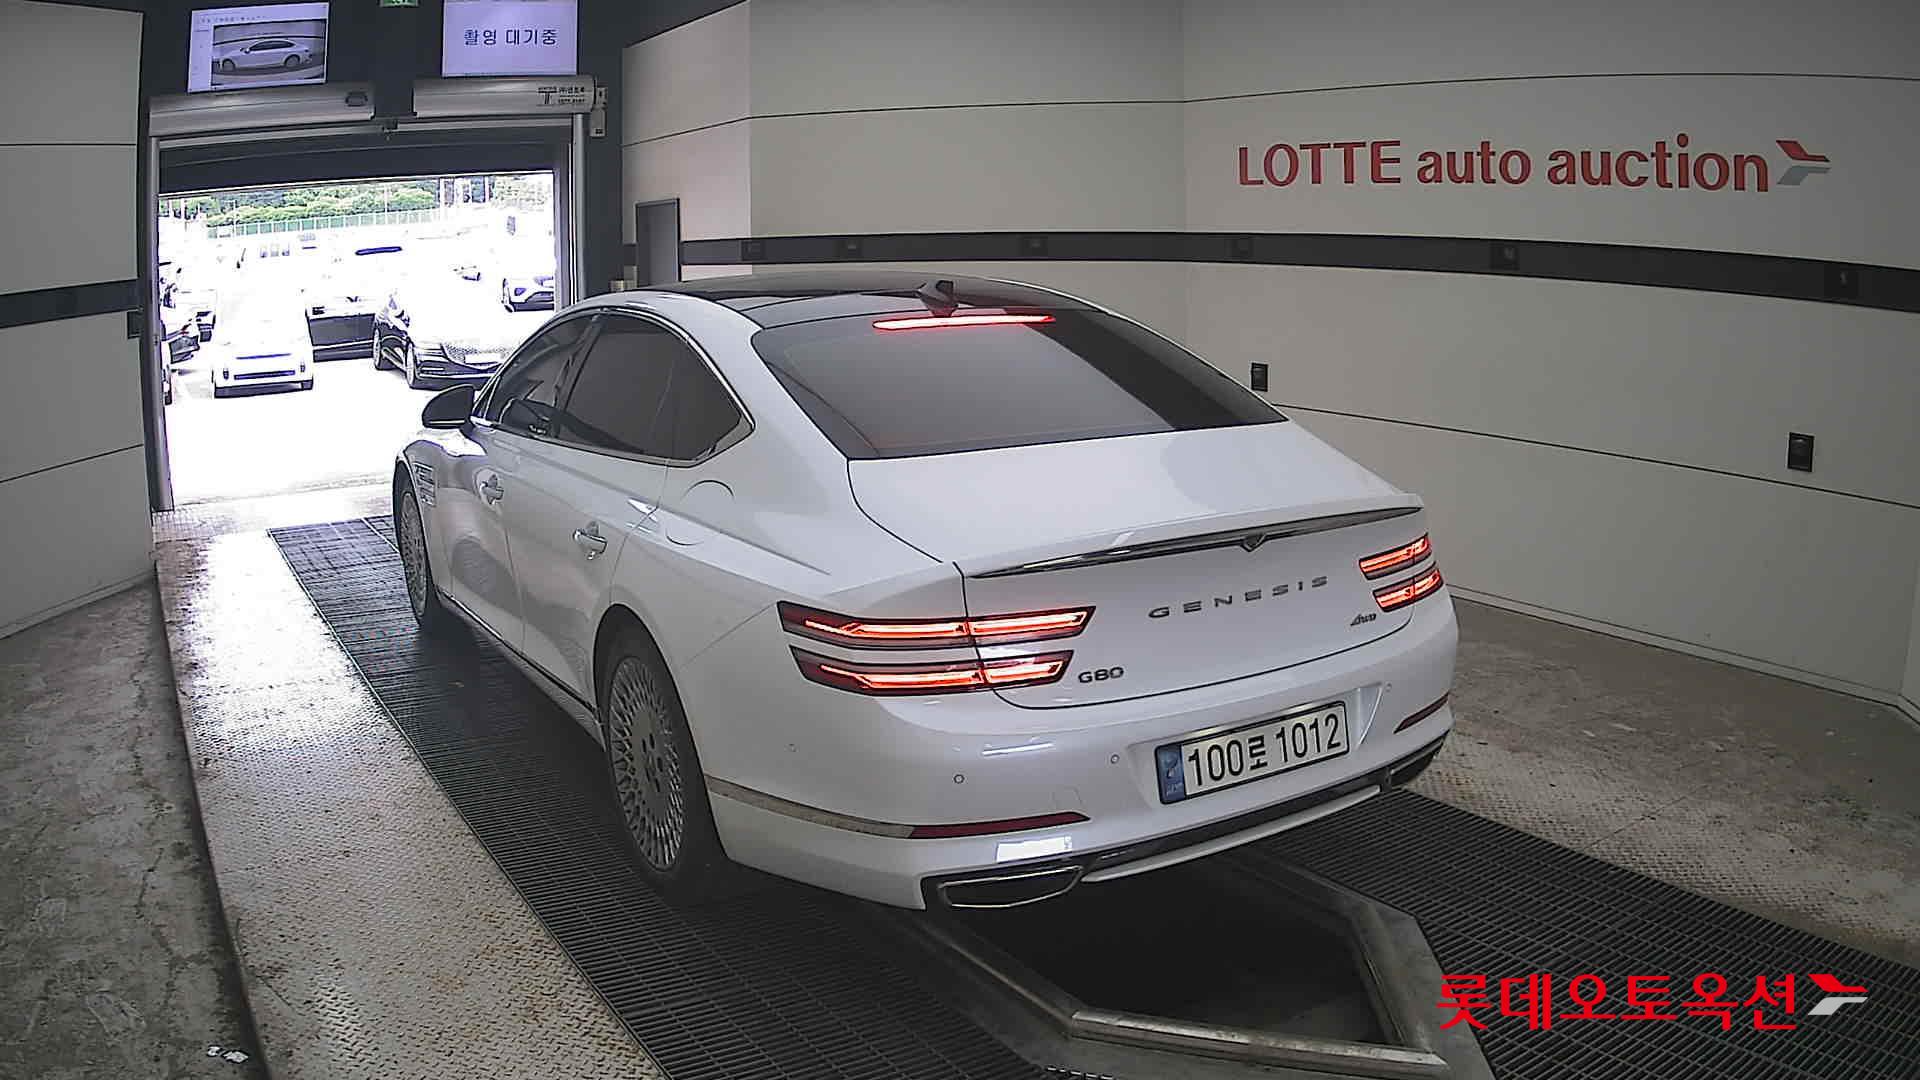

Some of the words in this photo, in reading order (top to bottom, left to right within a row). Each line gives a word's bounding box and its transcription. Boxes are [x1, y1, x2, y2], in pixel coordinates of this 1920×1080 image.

[464, 29, 497, 46] 촬영
[505, 29, 558, 46] 대기중
[1238, 139, 1401, 187] LOTTE
[1416, 140, 1532, 185] auto
[1547, 132, 1769, 193] auction
[1148, 575, 1328, 619] GENESIS
[1078, 666, 1125, 684] G80
[1274, 713, 1342, 764] 1012
